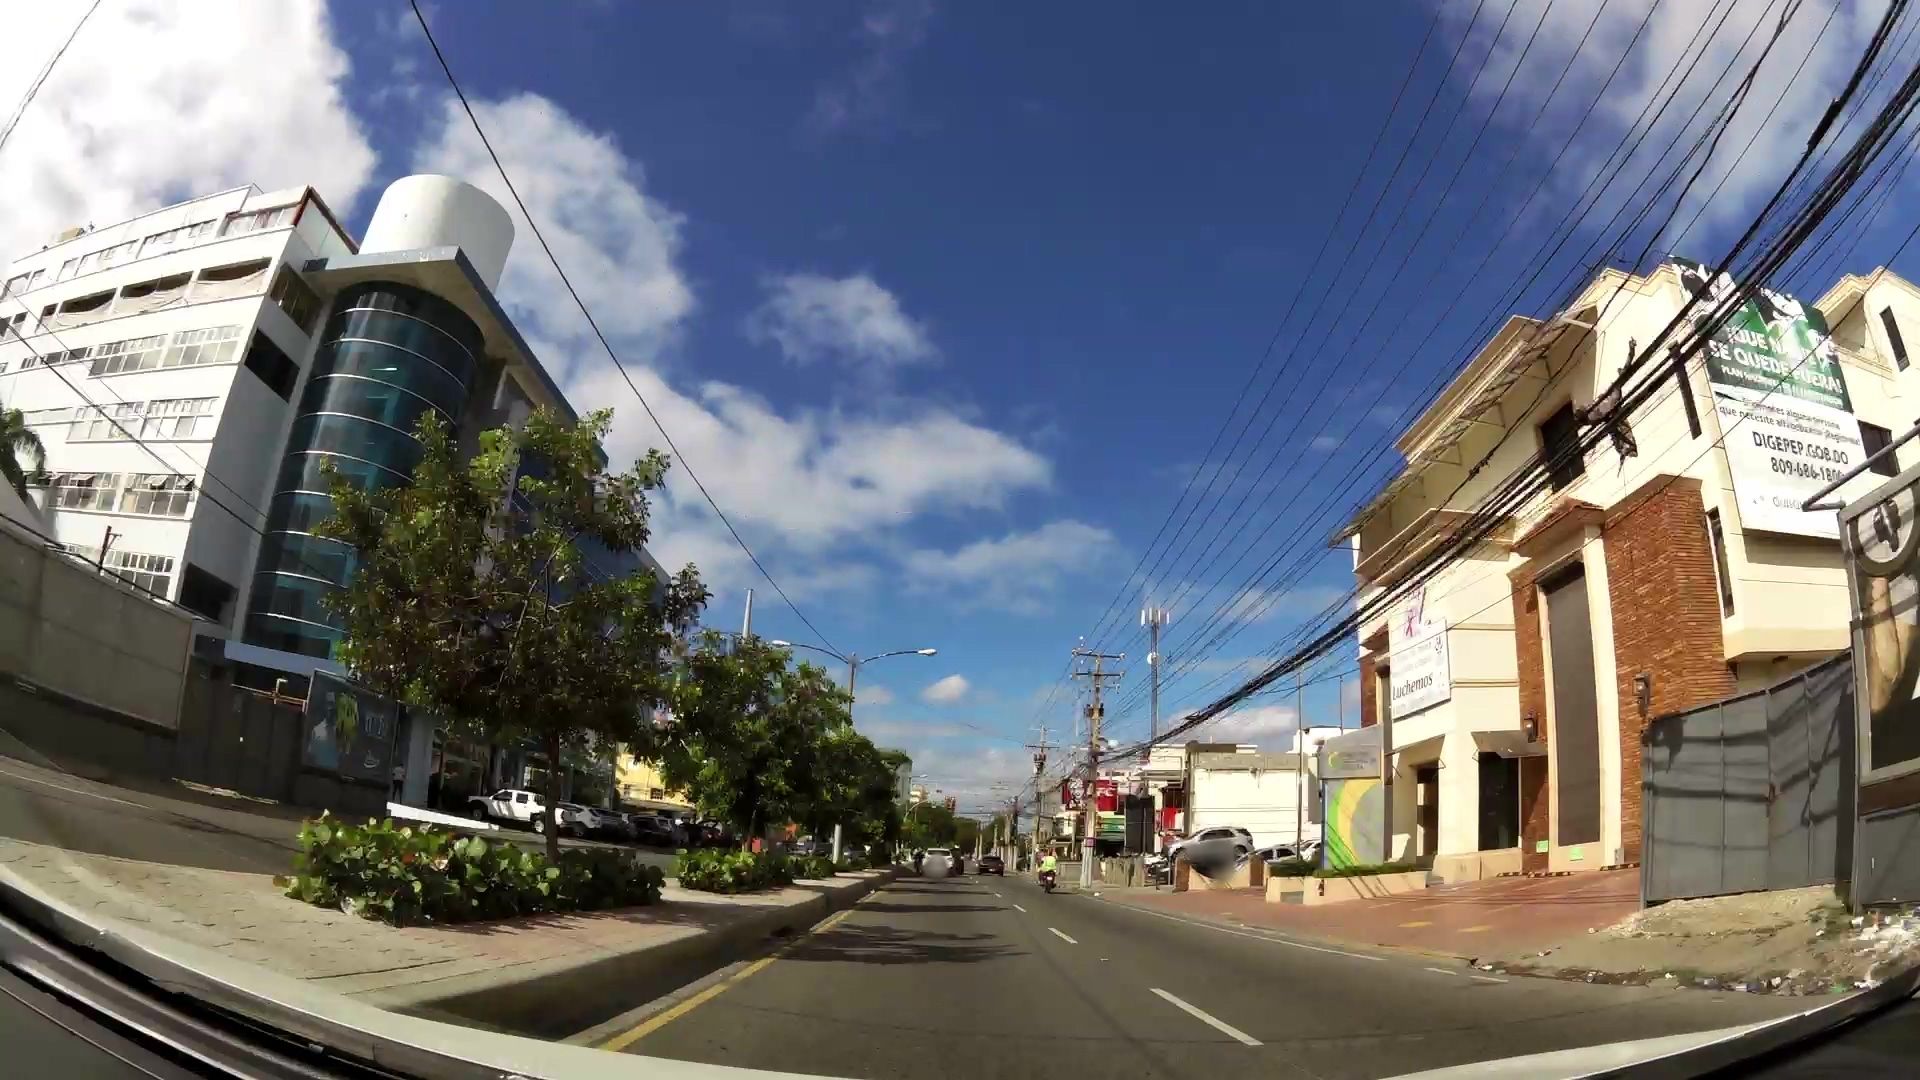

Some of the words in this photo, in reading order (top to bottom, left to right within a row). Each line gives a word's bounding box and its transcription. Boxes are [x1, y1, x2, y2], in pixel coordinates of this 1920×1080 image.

[1708, 339, 1732, 361] SE
[1734, 347, 1790, 378] QUEDE
[1719, 406, 1737, 417] que
[1392, 671, 1434, 701] Luchemos
